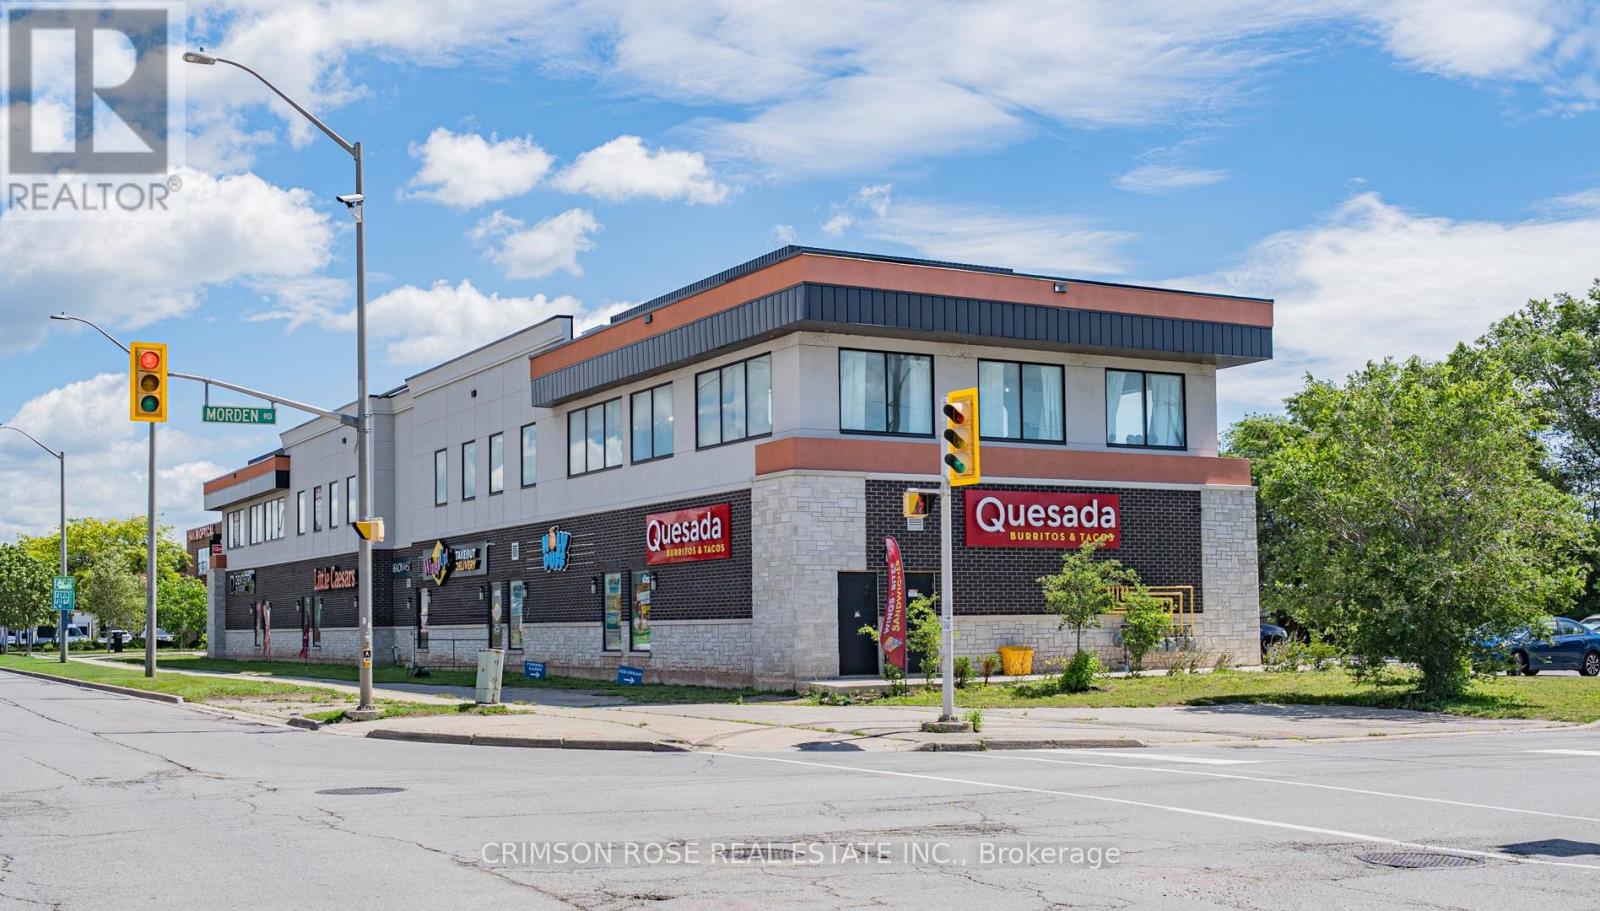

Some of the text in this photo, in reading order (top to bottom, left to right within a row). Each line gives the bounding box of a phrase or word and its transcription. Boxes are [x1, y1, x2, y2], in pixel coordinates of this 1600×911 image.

[206, 406, 273, 423] MORDEN RD
[976, 496, 1116, 533] Quesada
[646, 511, 722, 552] Quesada
[1009, 531, 1066, 541] BURRITOS
[1069, 532, 1076, 541] &
[455, 548, 476, 561] TAKEOUT
[666, 543, 726, 558] BURRITOS & TACOS
[455, 559, 477, 572] DELIVERY
[313, 565, 356, 591] Little Caesars
[883, 596, 896, 635] WINGS
